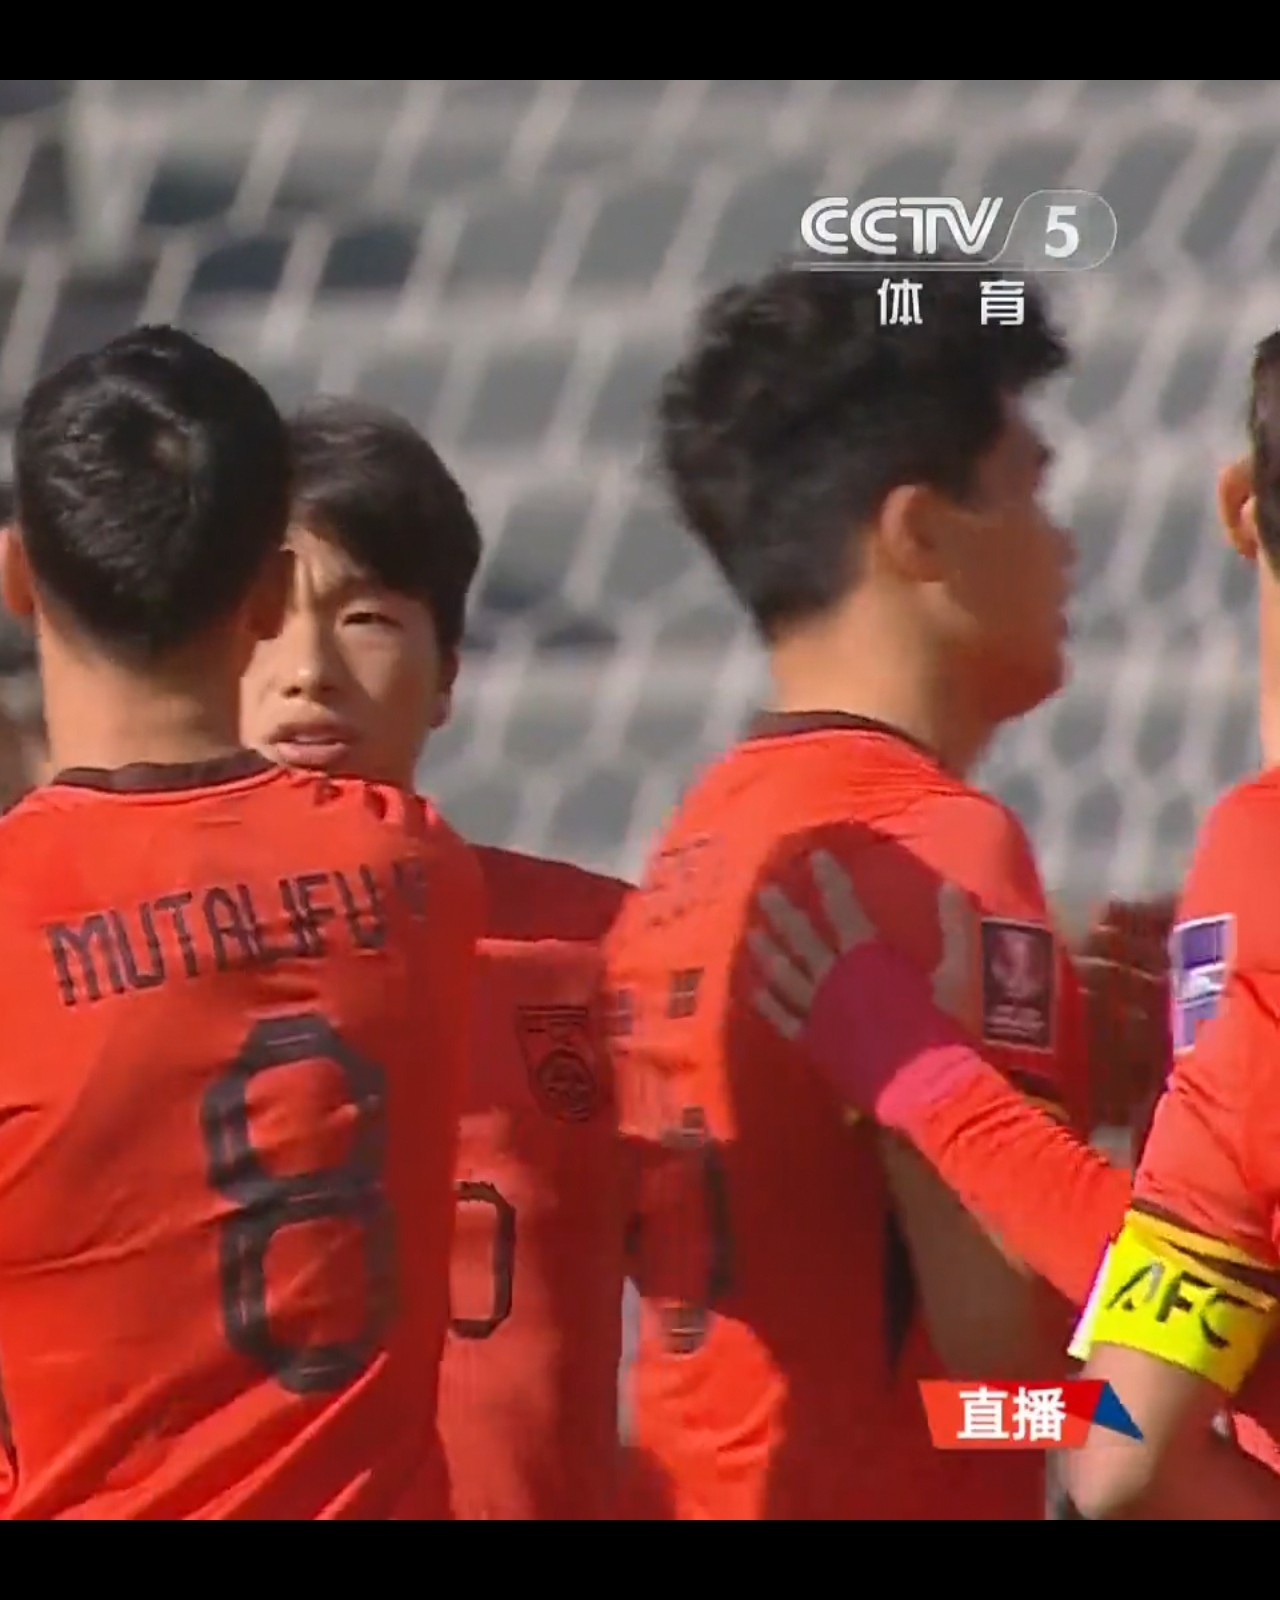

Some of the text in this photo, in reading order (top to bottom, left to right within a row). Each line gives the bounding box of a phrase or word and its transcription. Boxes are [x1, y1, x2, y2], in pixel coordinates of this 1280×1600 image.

[45, 864, 387, 1006] MUTALIFU
[200, 1009, 397, 1395] 8
[1106, 1261, 1248, 1349] AFC
